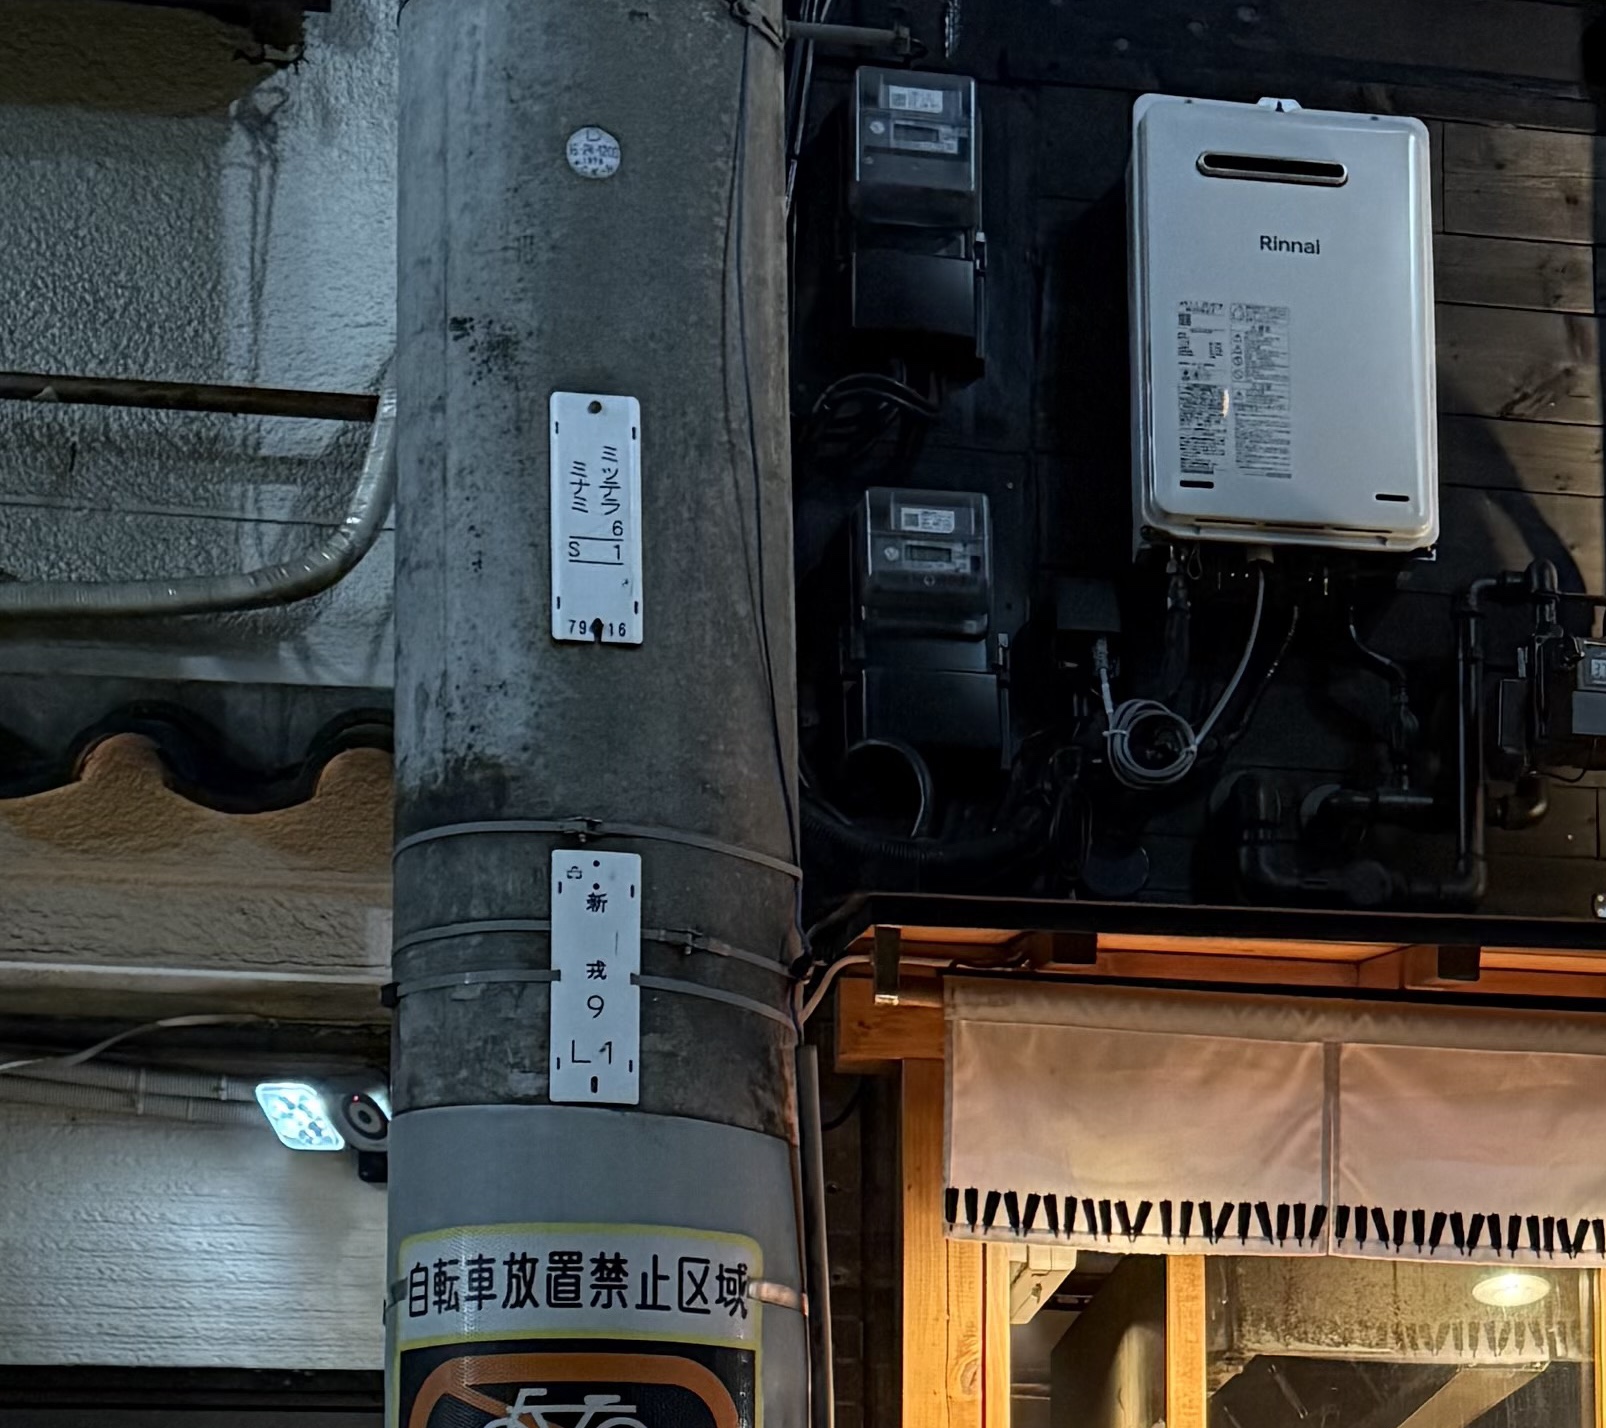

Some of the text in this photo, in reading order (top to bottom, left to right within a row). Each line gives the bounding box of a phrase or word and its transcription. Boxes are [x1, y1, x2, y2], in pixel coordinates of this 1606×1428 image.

[1259, 235, 1321, 254] Rinnai
[569, 461, 591, 513] ミナミ
[599, 445, 622, 515] ミツテラ
[612, 520, 624, 537] 6
[569, 541, 621, 560] S 1
[569, 620, 626, 637] 79 16
[587, 994, 605, 1018] 9
[408, 1251, 749, 1319] 自転車放置禁止区域
